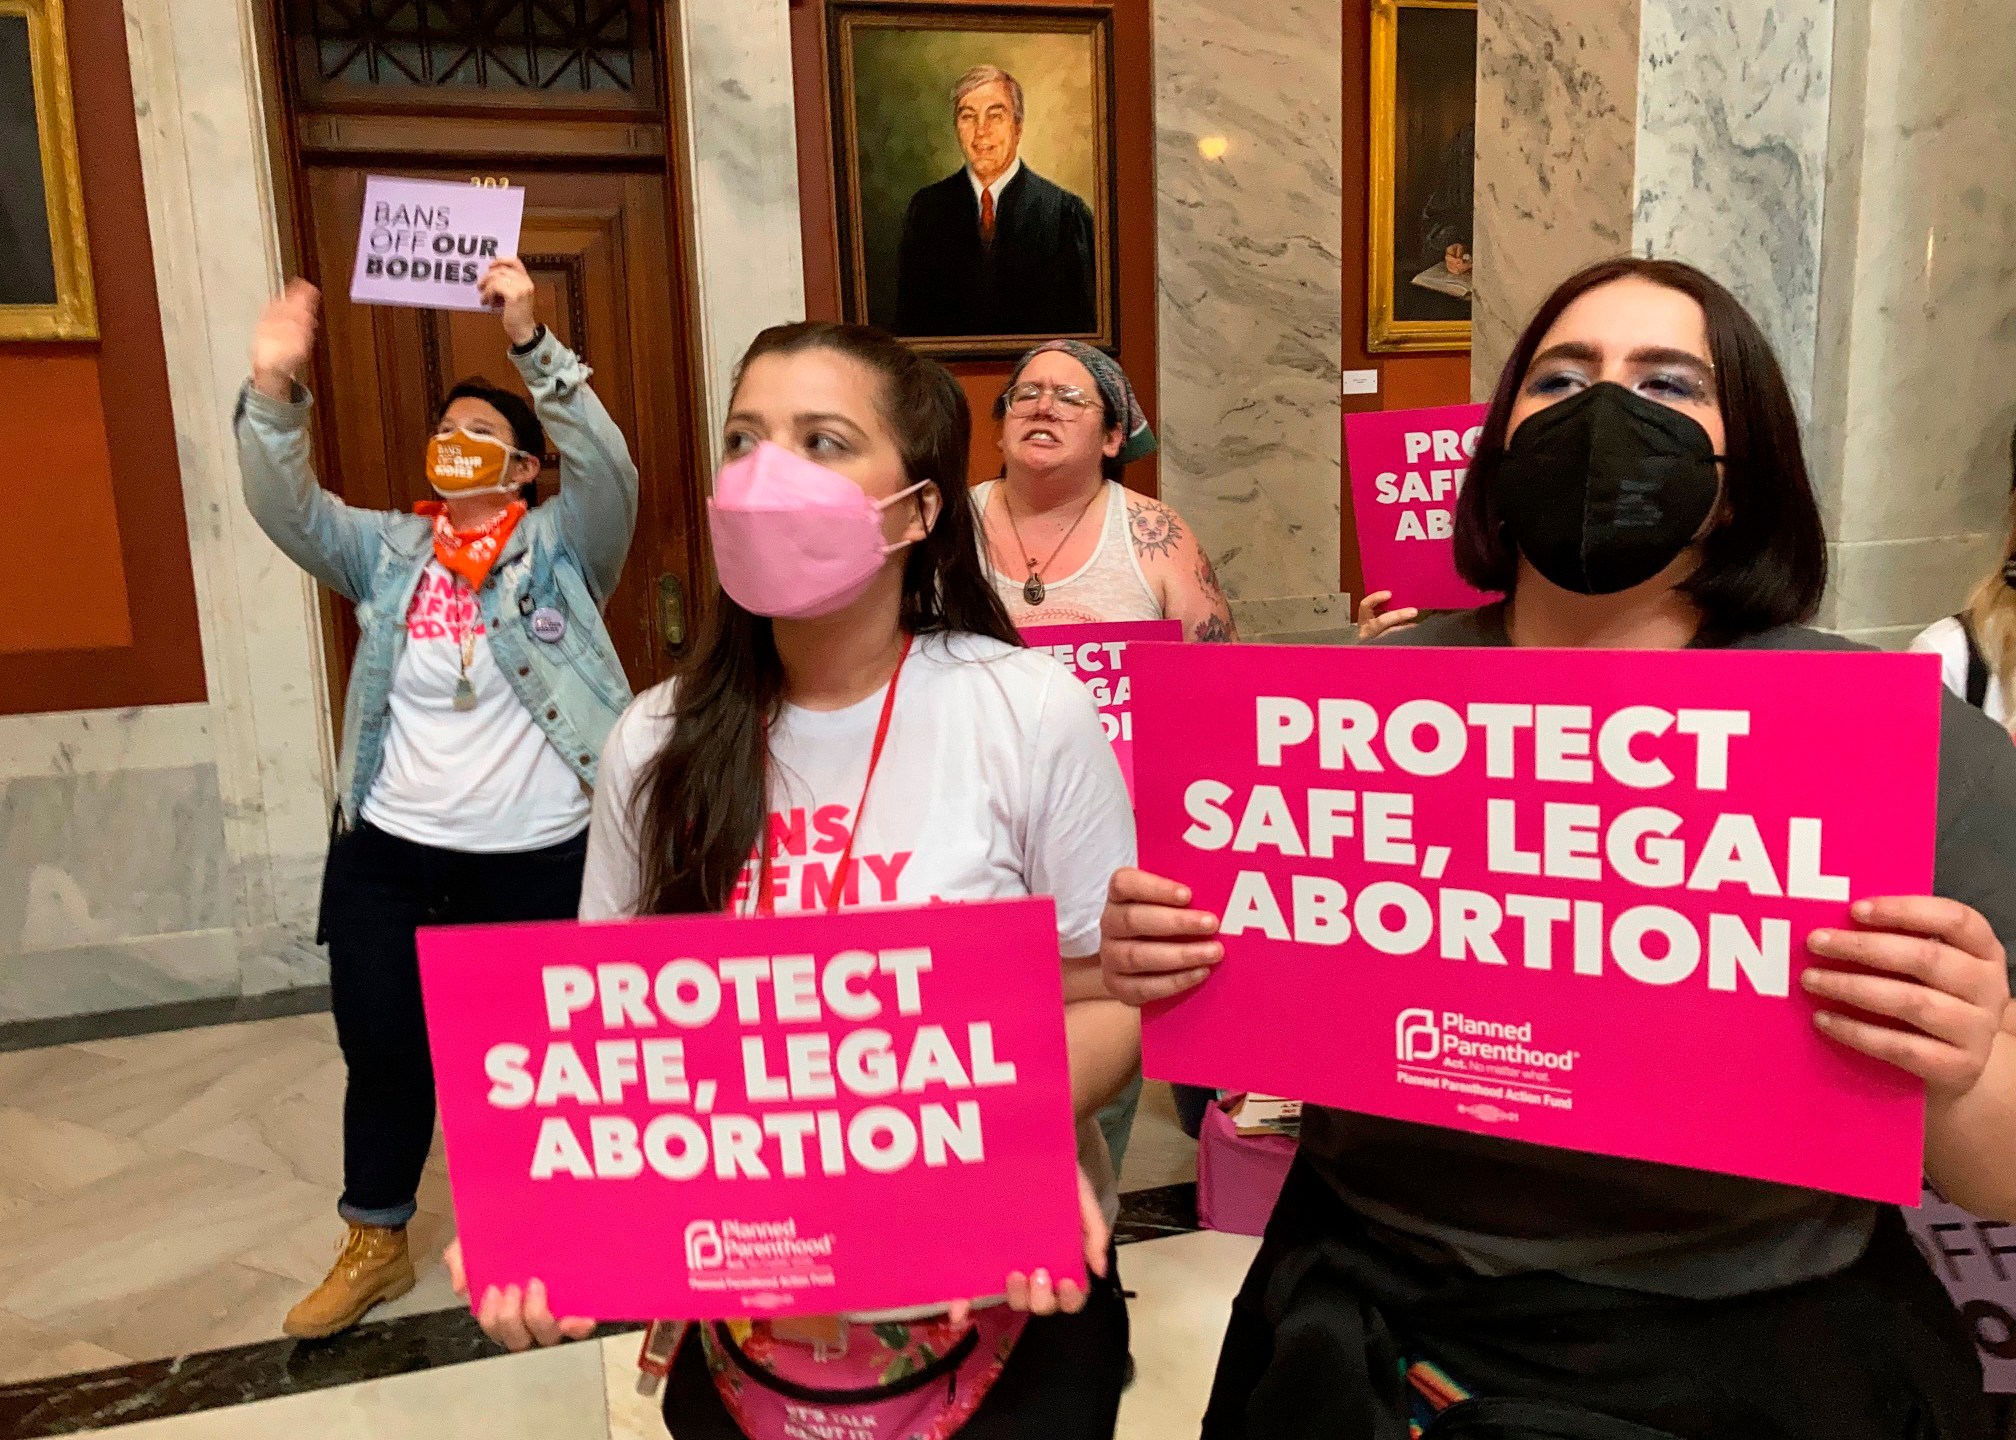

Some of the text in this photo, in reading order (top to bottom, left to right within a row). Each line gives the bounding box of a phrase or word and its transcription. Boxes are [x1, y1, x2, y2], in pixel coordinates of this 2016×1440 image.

[375, 201, 450, 231] BANS
[370, 228, 498, 259] OFF OUR
[366, 254, 478, 285] BODIES
[1256, 696, 1750, 790] PROTECT
[1183, 780, 1850, 902] SAFE, LEGAL
[802, 852, 912, 909] MY
[1219, 871, 1790, 996] ABORTION
[542, 948, 932, 1030] PROTECT
[1443, 1012, 1532, 1042] Planned
[484, 1022, 1017, 1112] SAFE, LEGAL
[1443, 1034, 1573, 1070] Parenthood
[1397, 1072, 1573, 1110] Planned Parenthood Action Fund
[530, 1101, 985, 1180] ABORTION
[722, 1217, 796, 1239] Planned
[725, 1234, 831, 1258] Parenthood
